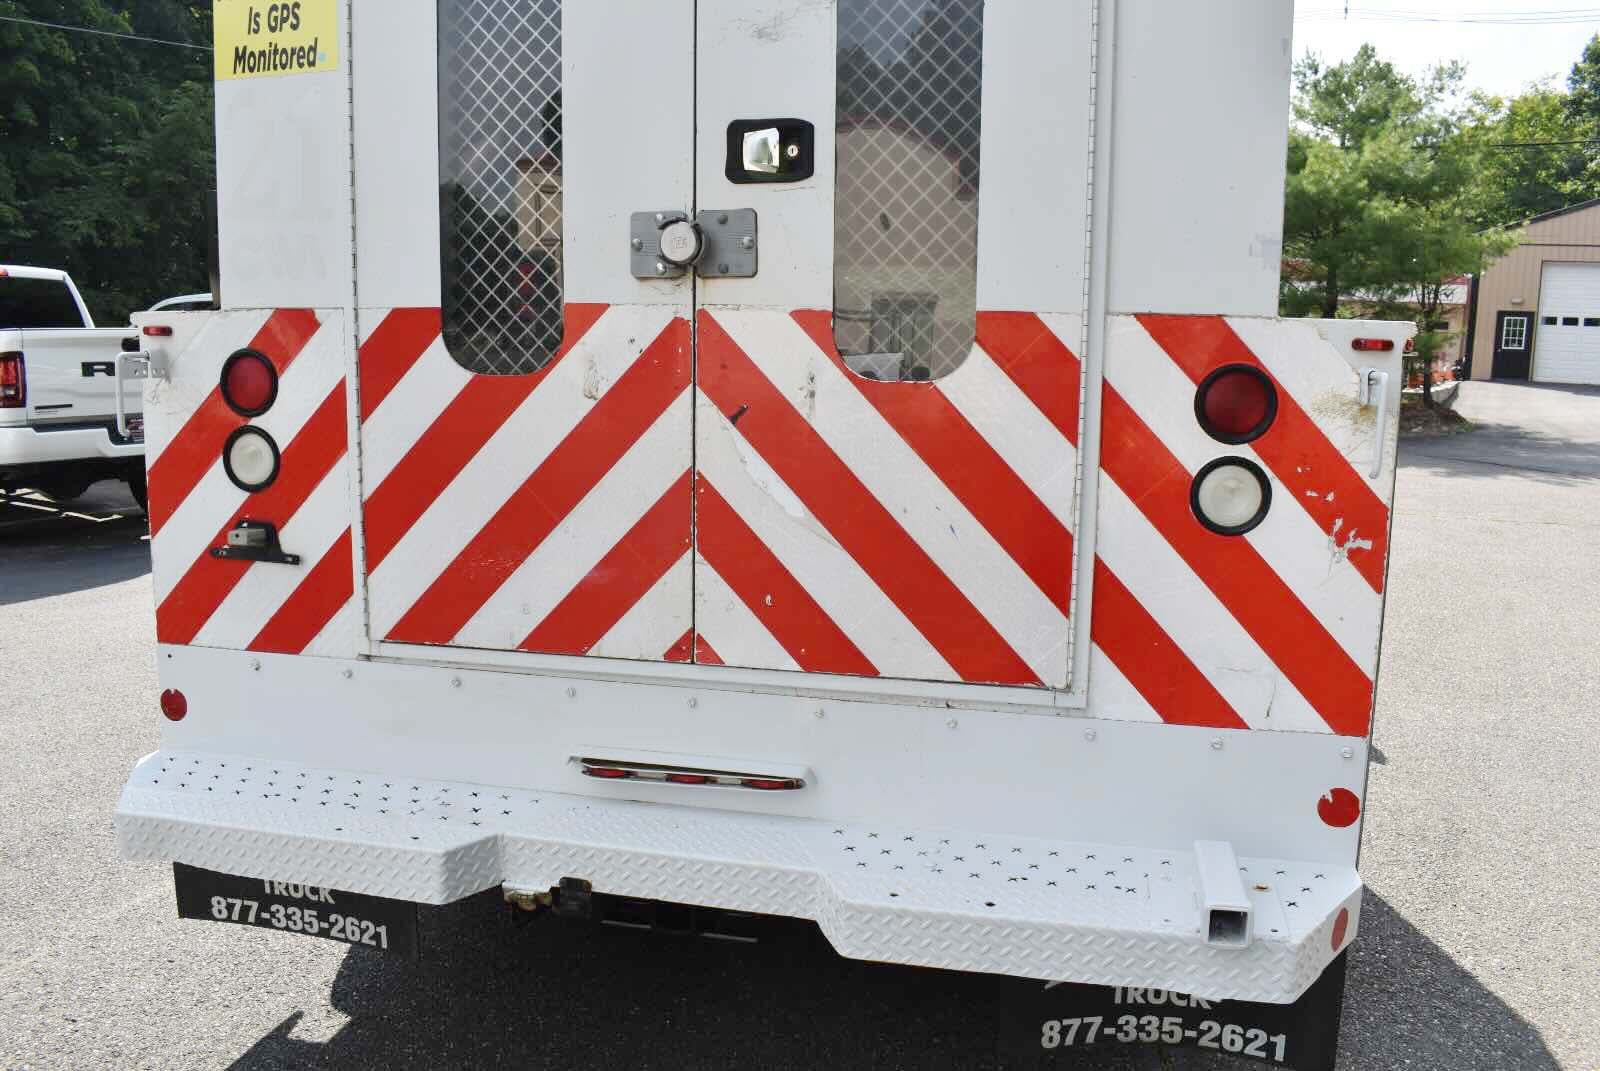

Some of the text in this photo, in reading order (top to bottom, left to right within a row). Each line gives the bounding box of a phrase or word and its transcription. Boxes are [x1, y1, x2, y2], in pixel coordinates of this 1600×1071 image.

[248, 1, 301, 35] Is GPS
[233, 36, 318, 74] Monitored
[210, 895, 389, 949] 877-335-2621
[1040, 1014, 1287, 1062] 877-335-2621
